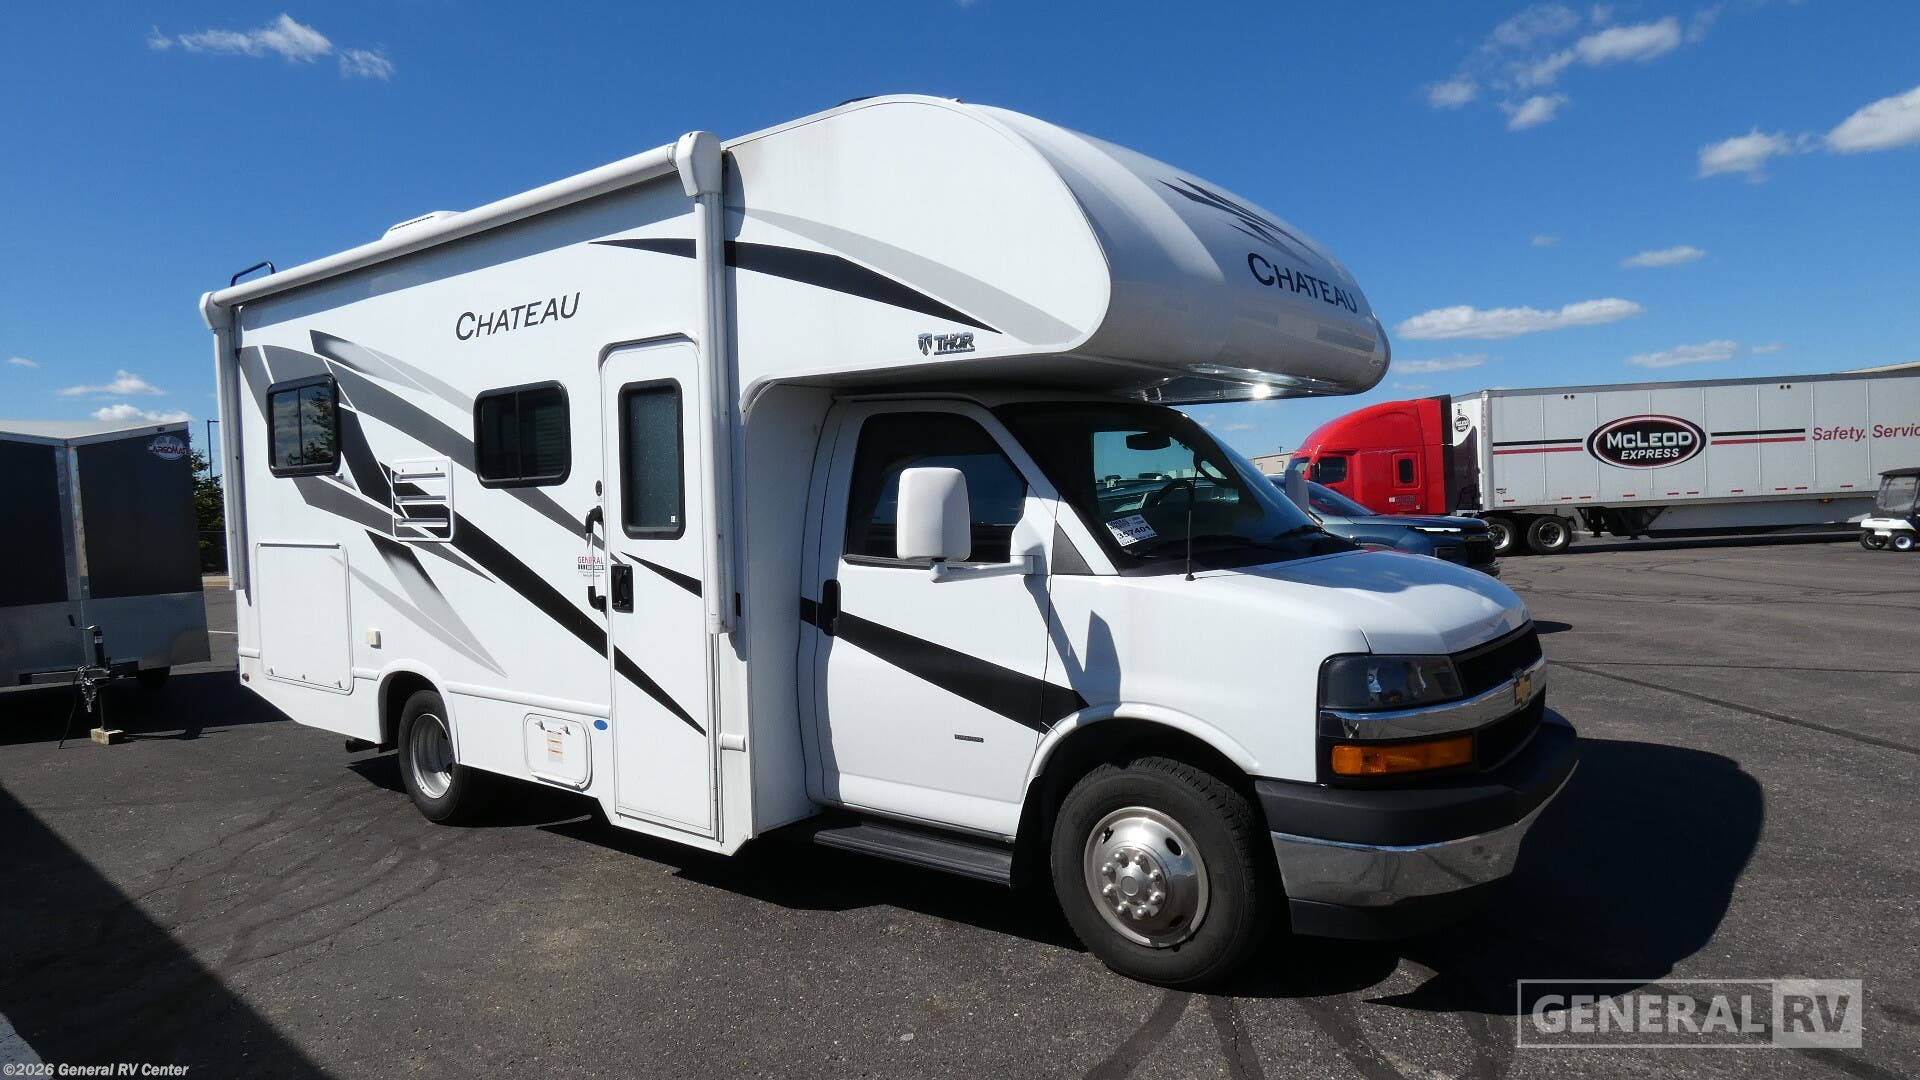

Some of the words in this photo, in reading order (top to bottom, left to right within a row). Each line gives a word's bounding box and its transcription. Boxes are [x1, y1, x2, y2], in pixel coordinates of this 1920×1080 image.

[1248, 253, 1358, 313] CHATEAU
[455, 291, 580, 341] CHATEAU
[934, 332, 975, 351] THOR
[1812, 426, 1866, 442] Safety.
[1620, 447, 1680, 460] EXPRESS
